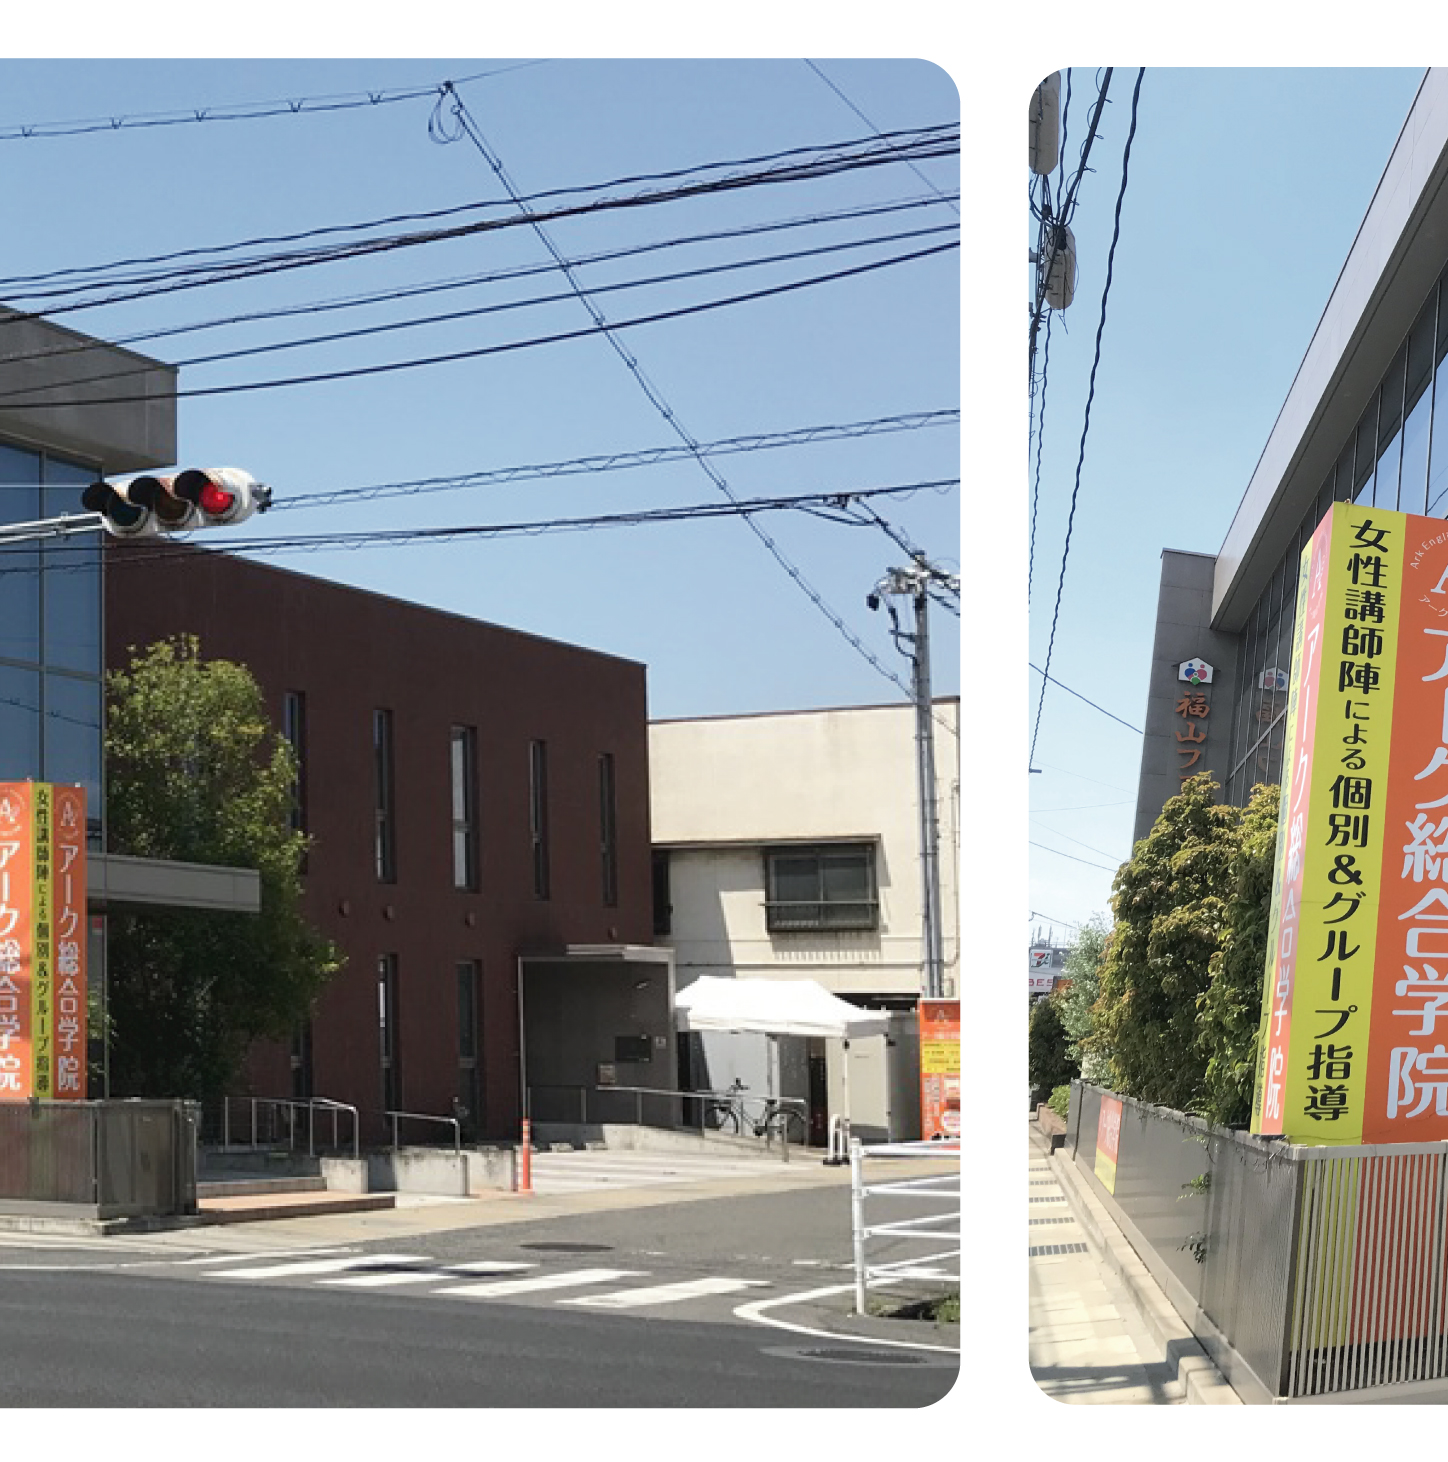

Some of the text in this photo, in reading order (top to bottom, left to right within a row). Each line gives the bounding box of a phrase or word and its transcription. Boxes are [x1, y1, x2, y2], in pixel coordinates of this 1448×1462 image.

[1410, 551, 1425, 569] Ark
[1175, 690, 1210, 780] 福山フ
[1303, 520, 1391, 1121] 女性講師陣による個別&グループ指導
[58, 845, 79, 1092] アーク総合学院
[1265, 623, 1320, 1120] アーク総合学院
